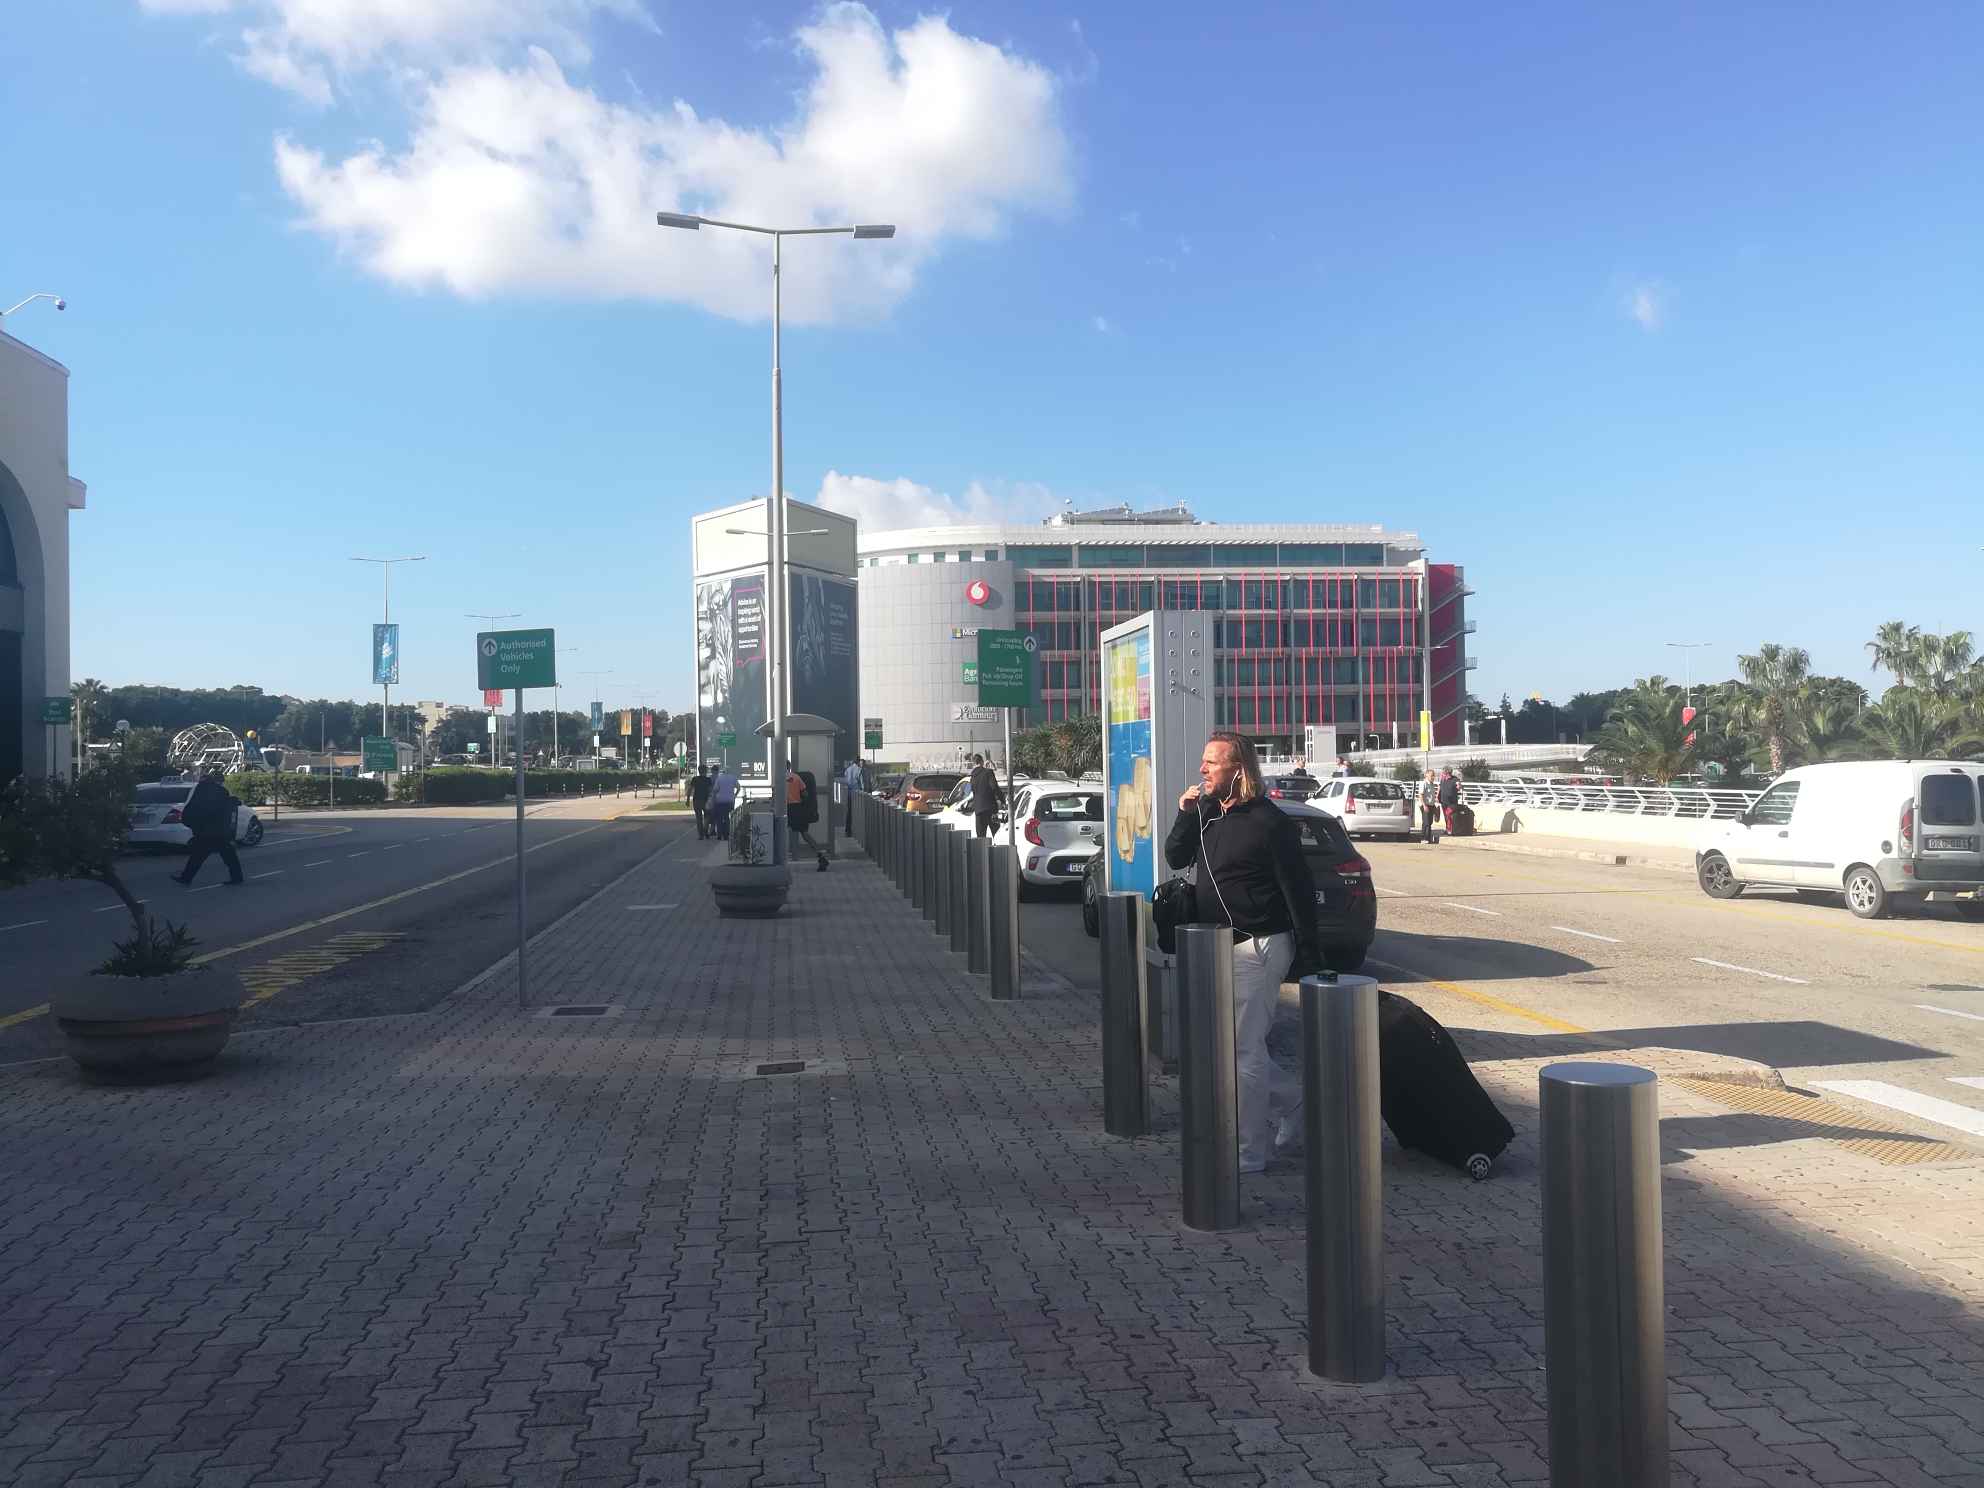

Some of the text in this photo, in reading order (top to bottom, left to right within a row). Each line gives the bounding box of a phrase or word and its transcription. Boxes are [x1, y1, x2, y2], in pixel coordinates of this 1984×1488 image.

[501, 638, 546, 649] Authorised
[500, 651, 534, 661] Vehicles
[501, 663, 520, 674] Only
[753, 762, 765, 772] BOV
